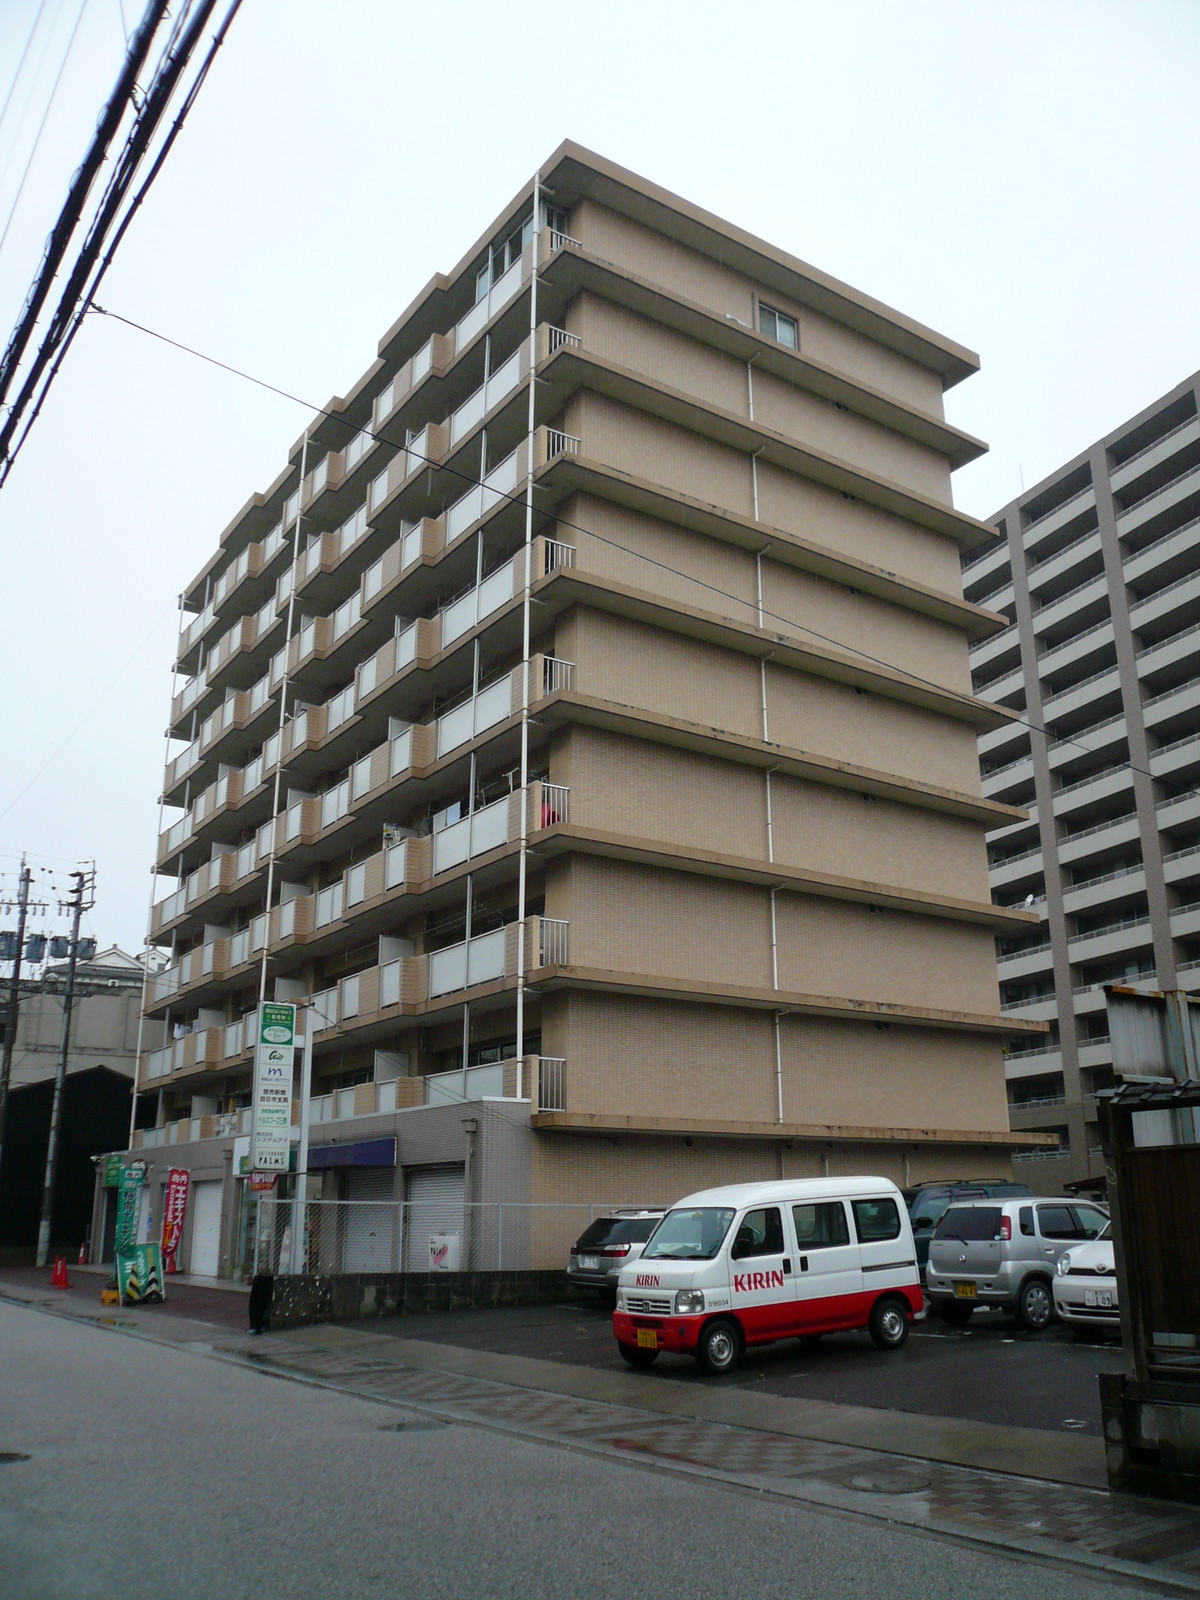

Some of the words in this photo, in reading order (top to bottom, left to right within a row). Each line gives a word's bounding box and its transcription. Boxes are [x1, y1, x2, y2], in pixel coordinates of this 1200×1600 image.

[258, 1157, 285, 1165] PALMS
[636, 1274, 661, 1287] KIRIN
[734, 1270, 784, 1292] KIRIN
[709, 1299, 729, 1308] 016034
